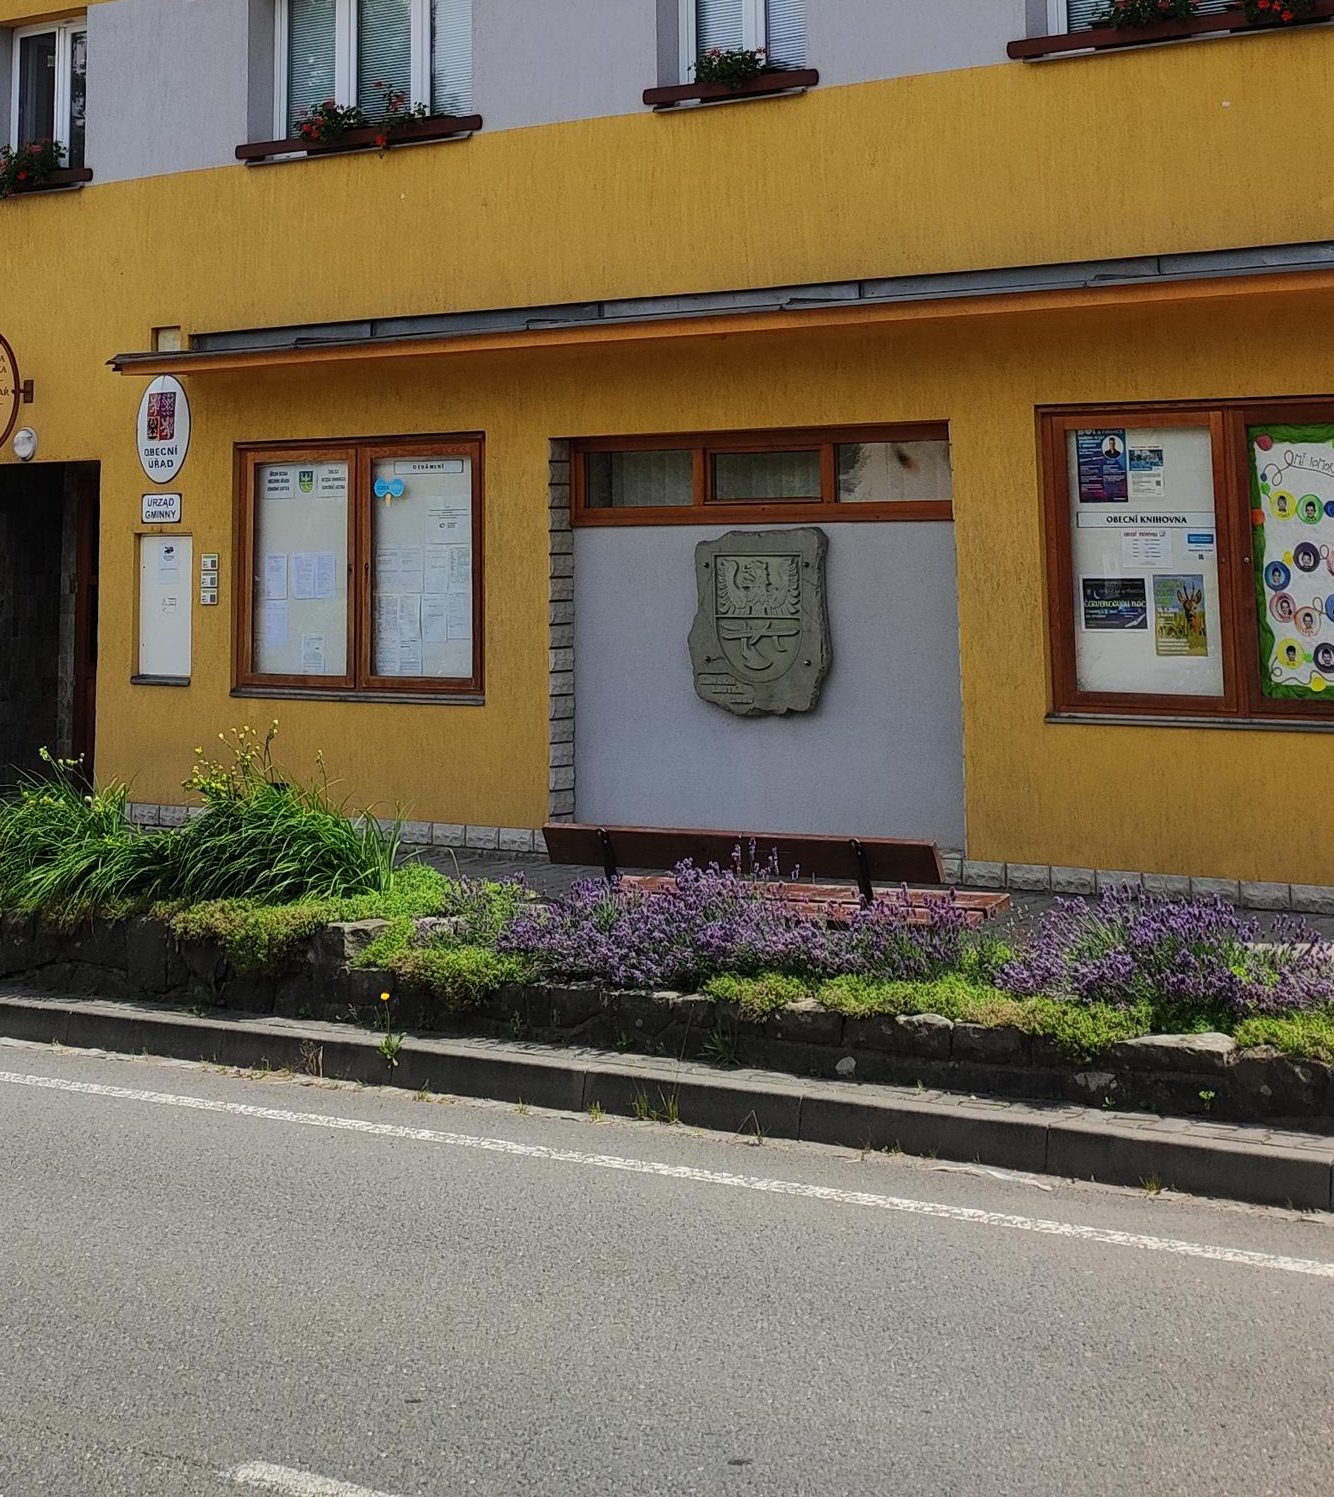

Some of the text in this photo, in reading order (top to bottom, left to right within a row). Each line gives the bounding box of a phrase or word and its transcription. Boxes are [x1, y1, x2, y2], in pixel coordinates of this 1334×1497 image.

[144, 445, 178, 456] OBECNÍ
[145, 510, 177, 520] GMINNY
[1106, 514, 1187, 524] OBECNÍ KNIHOVNA
